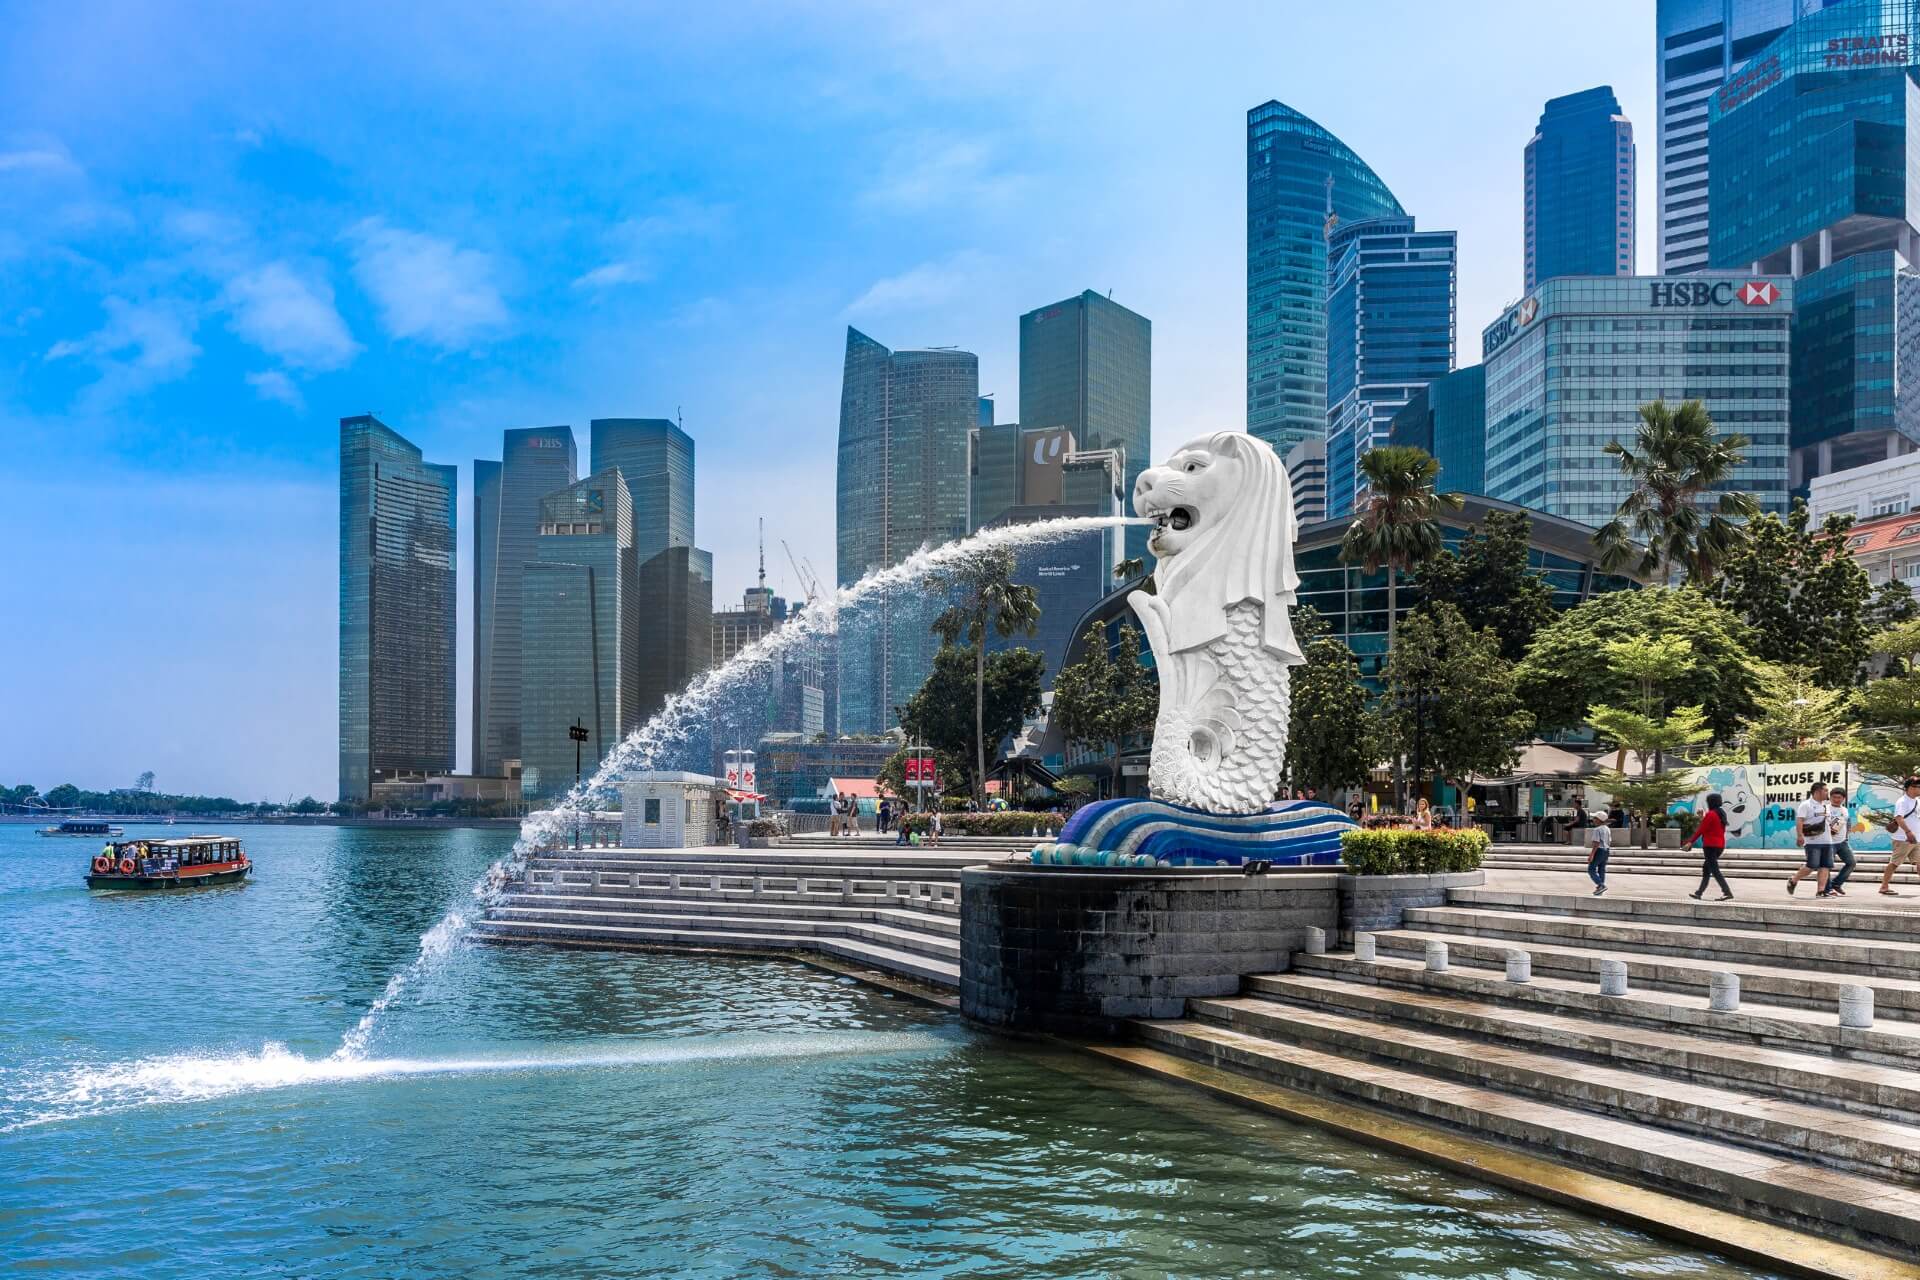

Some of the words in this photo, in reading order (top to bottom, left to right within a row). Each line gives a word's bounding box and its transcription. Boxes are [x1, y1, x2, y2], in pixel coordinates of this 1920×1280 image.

[1828, 34, 1908, 50] STRAITS
[1823, 50, 1908, 67] TRADING
[1650, 282, 1733, 307] HSBC
[1820, 771, 1841, 784] ME
[1766, 792, 1802, 804] WHILE
[1765, 809, 1775, 821] A
